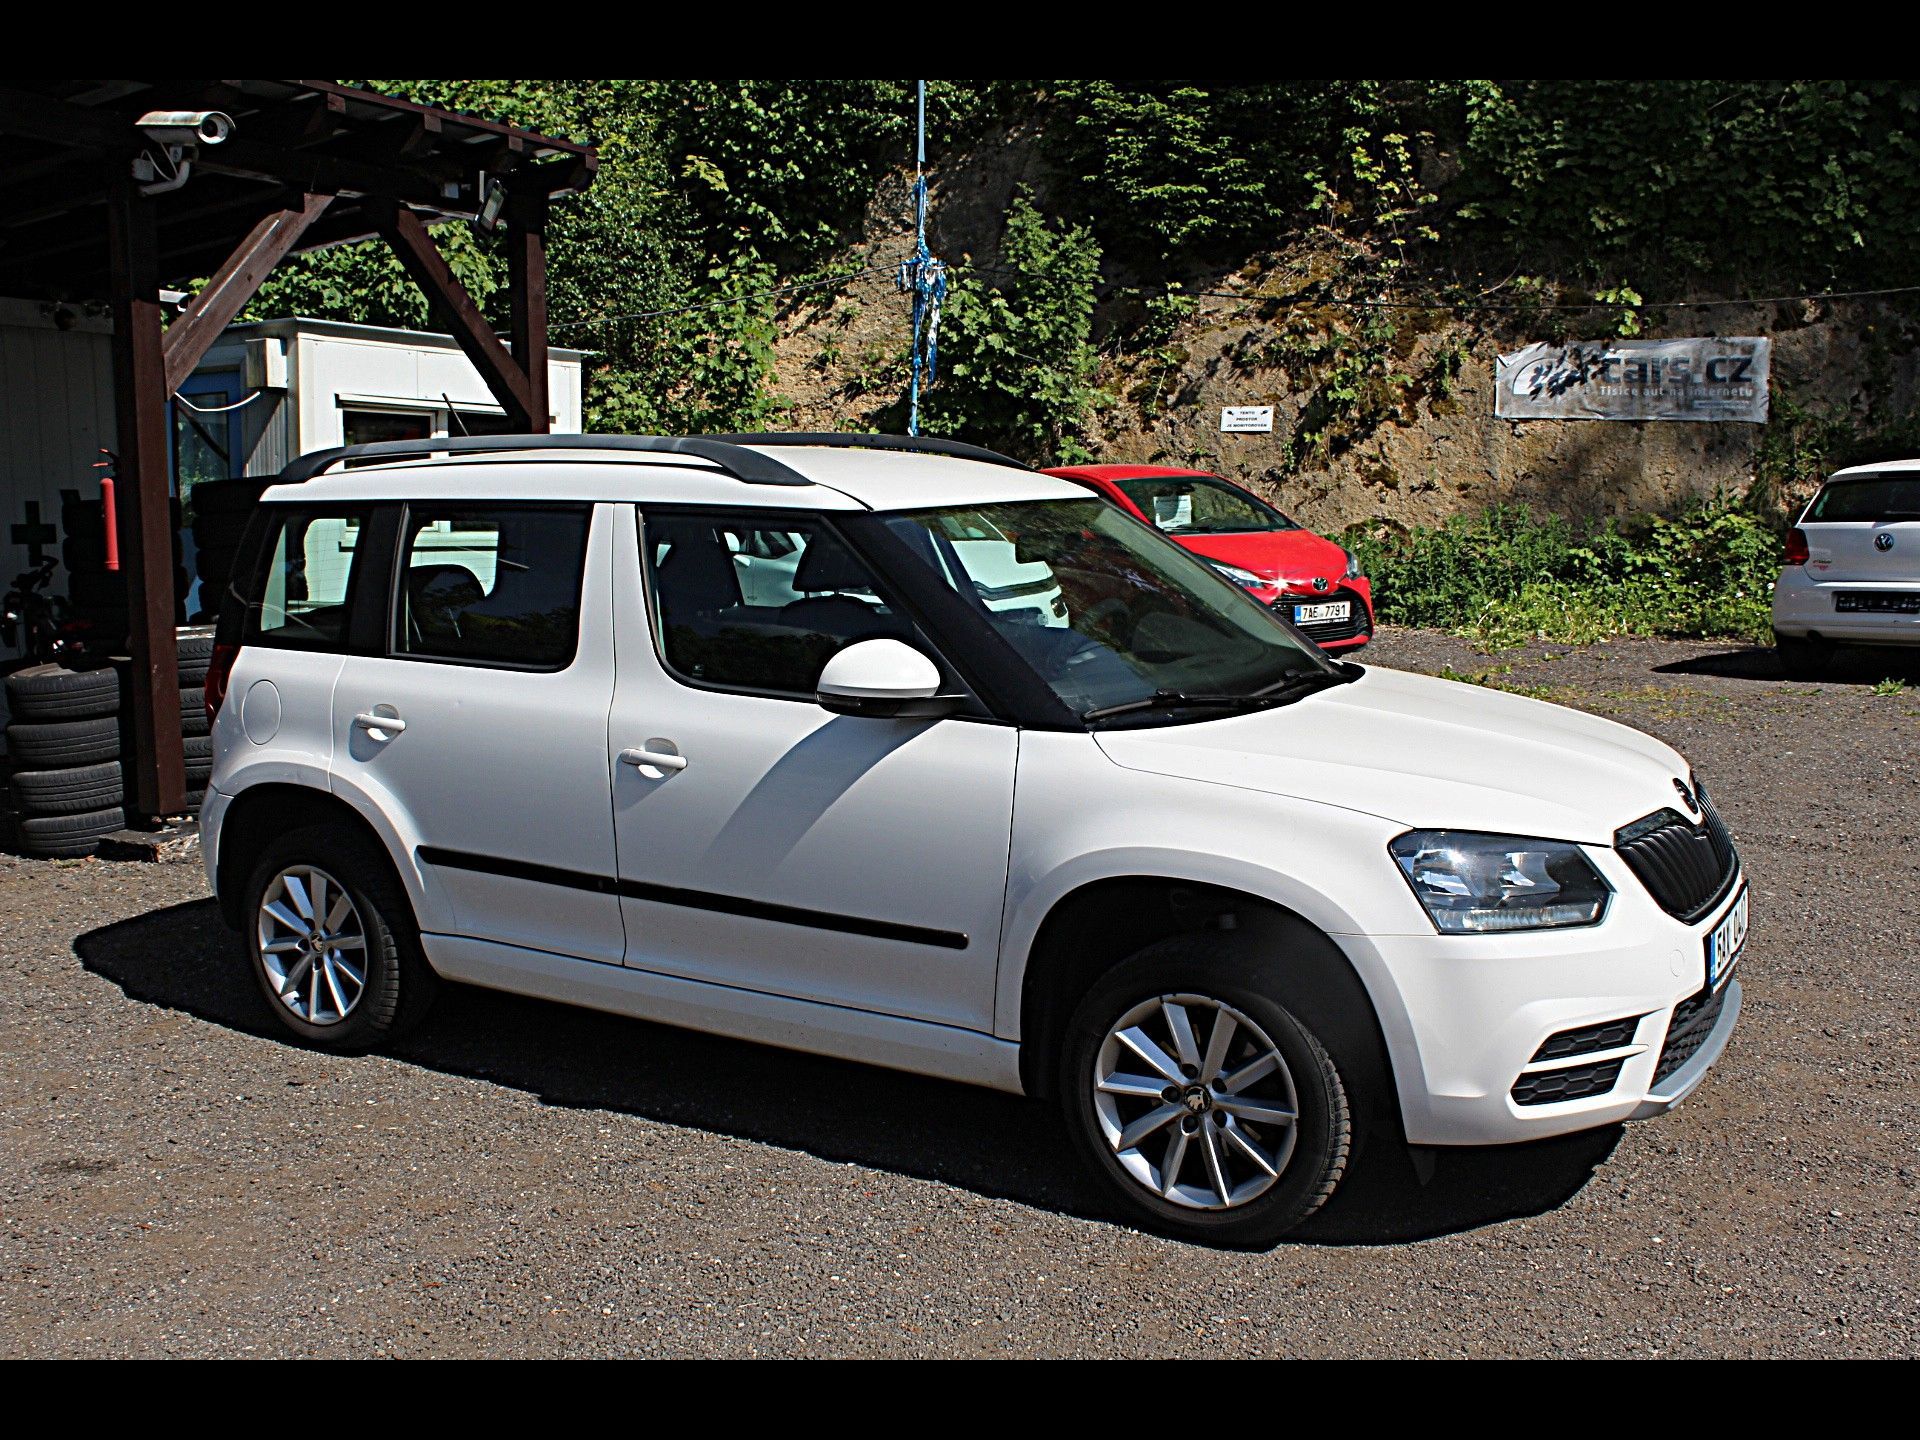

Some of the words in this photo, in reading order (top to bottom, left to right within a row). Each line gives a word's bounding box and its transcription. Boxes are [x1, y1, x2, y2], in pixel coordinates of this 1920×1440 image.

[1643, 386, 1664, 396] aut
[1670, 387, 1684, 396] na
[1689, 386, 1753, 396] internetu
[1303, 606, 1319, 619] 7AE
[1325, 604, 1346, 617] 7791
